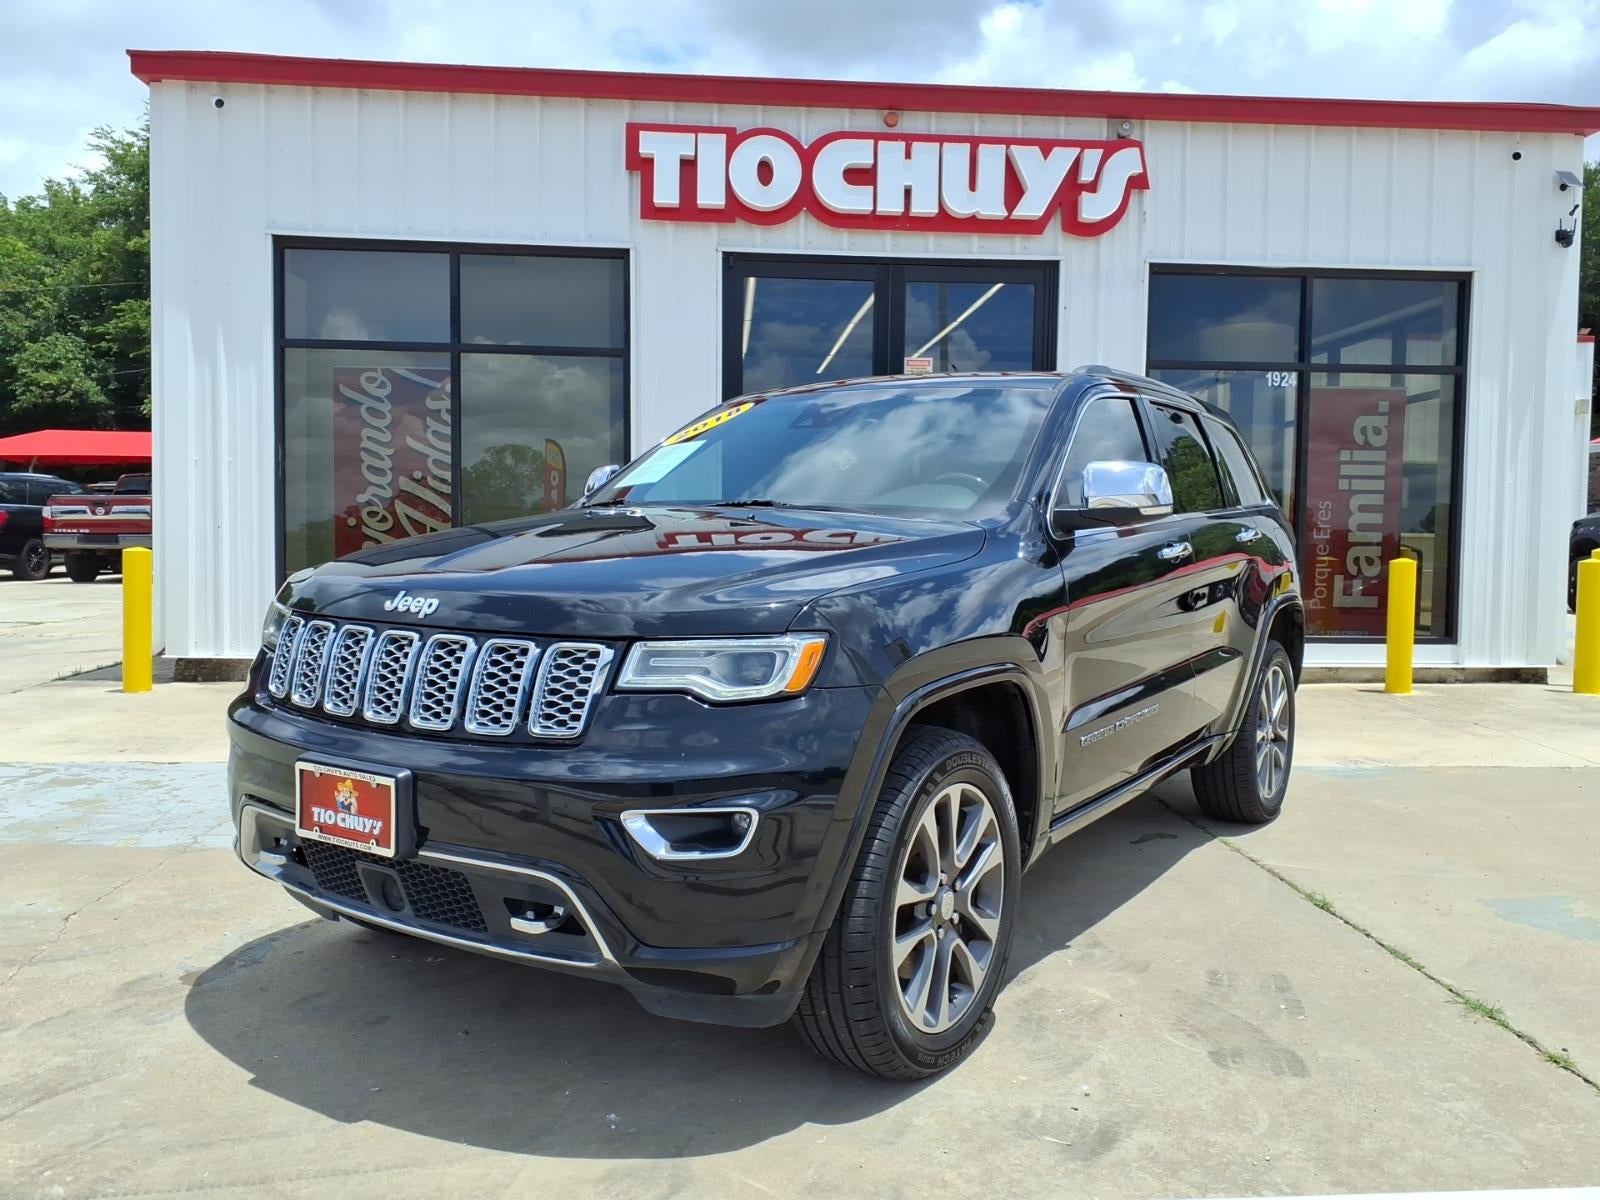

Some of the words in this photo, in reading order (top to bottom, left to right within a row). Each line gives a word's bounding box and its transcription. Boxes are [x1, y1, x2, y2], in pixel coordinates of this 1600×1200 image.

[639, 130, 802, 212] TIO
[812, 138, 1144, 223] CHUY'S
[1266, 371, 1297, 387] 1924
[1313, 500, 1332, 539] Eres
[1332, 400, 1390, 608] Familia.
[1309, 544, 1333, 609] Porque
[383, 590, 440, 619] Jeep
[343, 770, 358, 779] AUTO
[358, 773, 377, 782] SALES
[311, 806, 336, 825] TIO
[336, 812, 383, 836] CHUY'S
